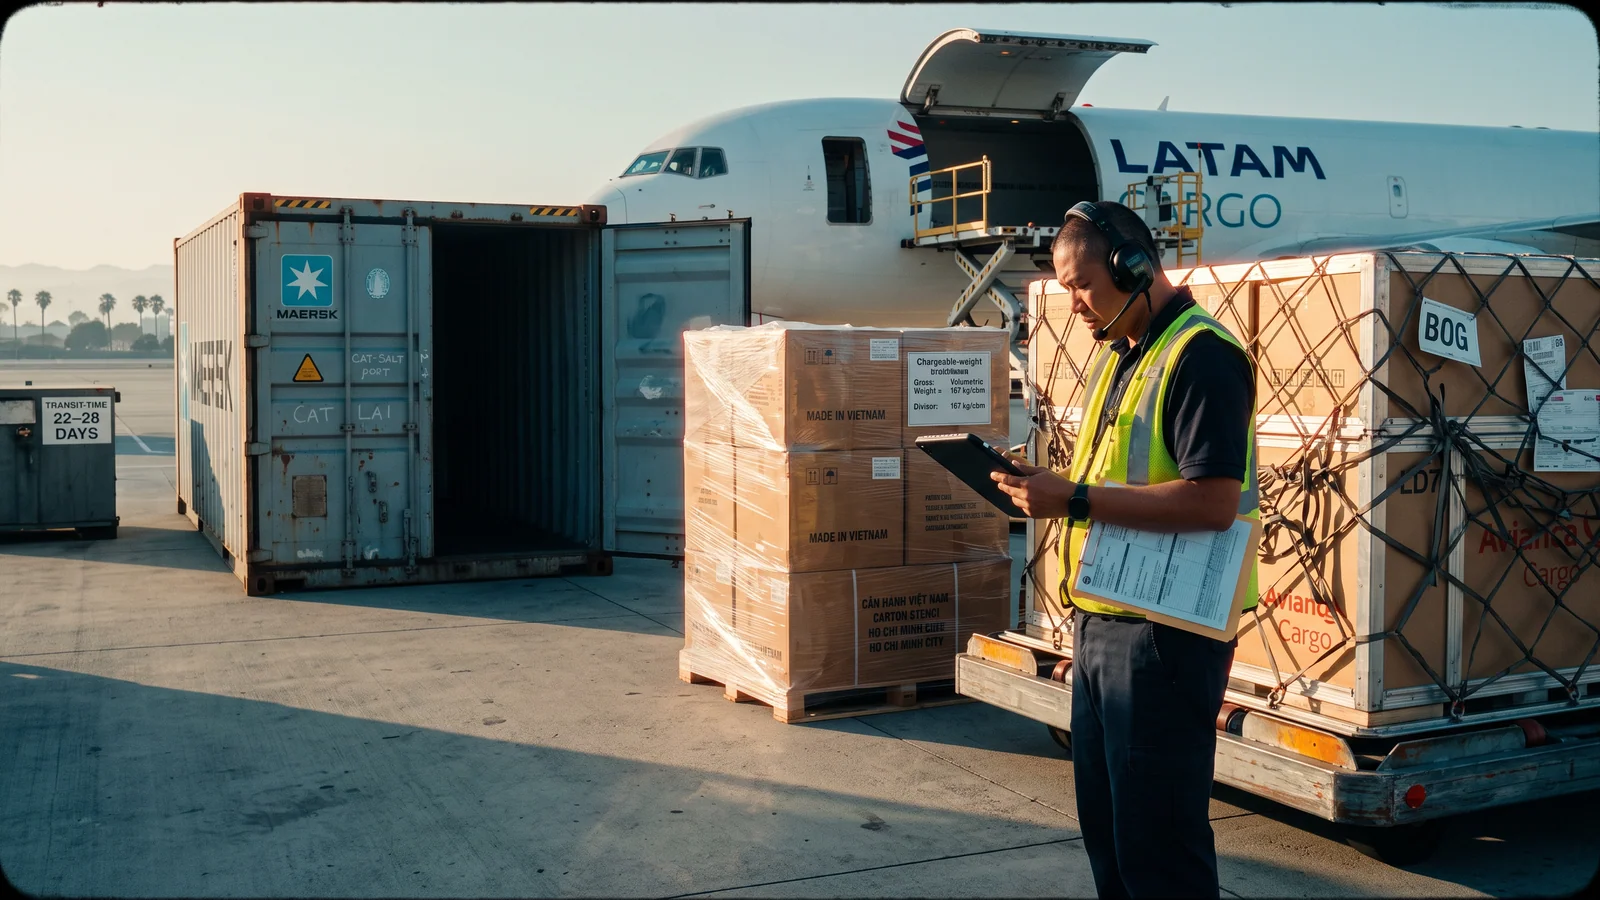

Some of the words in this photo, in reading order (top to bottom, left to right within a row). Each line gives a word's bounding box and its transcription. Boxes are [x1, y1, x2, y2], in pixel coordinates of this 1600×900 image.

[1110, 139, 1326, 180] LATAM
[277, 310, 338, 319] MAERSK
[1425, 312, 1468, 351] BOG
[352, 353, 405, 364] CAT-SALT
[917, 358, 982, 367] Chargeable-weight
[914, 387, 936, 395] Weight
[963, 387, 985, 395] kg/cbm
[45, 401, 107, 409] TRANSIT-TIME
[963, 402, 985, 410] kg/cbm
[294, 405, 334, 423] CAT
[359, 404, 390, 420] LAI
[807, 410, 832, 421] MADE
[836, 410, 844, 420] IN
[847, 409, 886, 420] VIETNAM
[56, 427, 98, 440] DAYS
[809, 532, 835, 543] MADE
[838, 531, 847, 542] IN
[849, 529, 888, 541] VIETNAM
[1524, 561, 1581, 590] Cargo
[930, 593, 949, 604] NAM
[873, 610, 907, 623] CARTON
[910, 608, 940, 620] STENCI
[868, 628, 881, 638] HO
[883, 627, 897, 637] CHI
[900, 624, 923, 635] MINH
[1278, 619, 1332, 653] Cargo
[869, 643, 881, 652] HO
[884, 641, 898, 651] CHI
[901, 639, 923, 649] MINH
[925, 636, 944, 647] CITY
